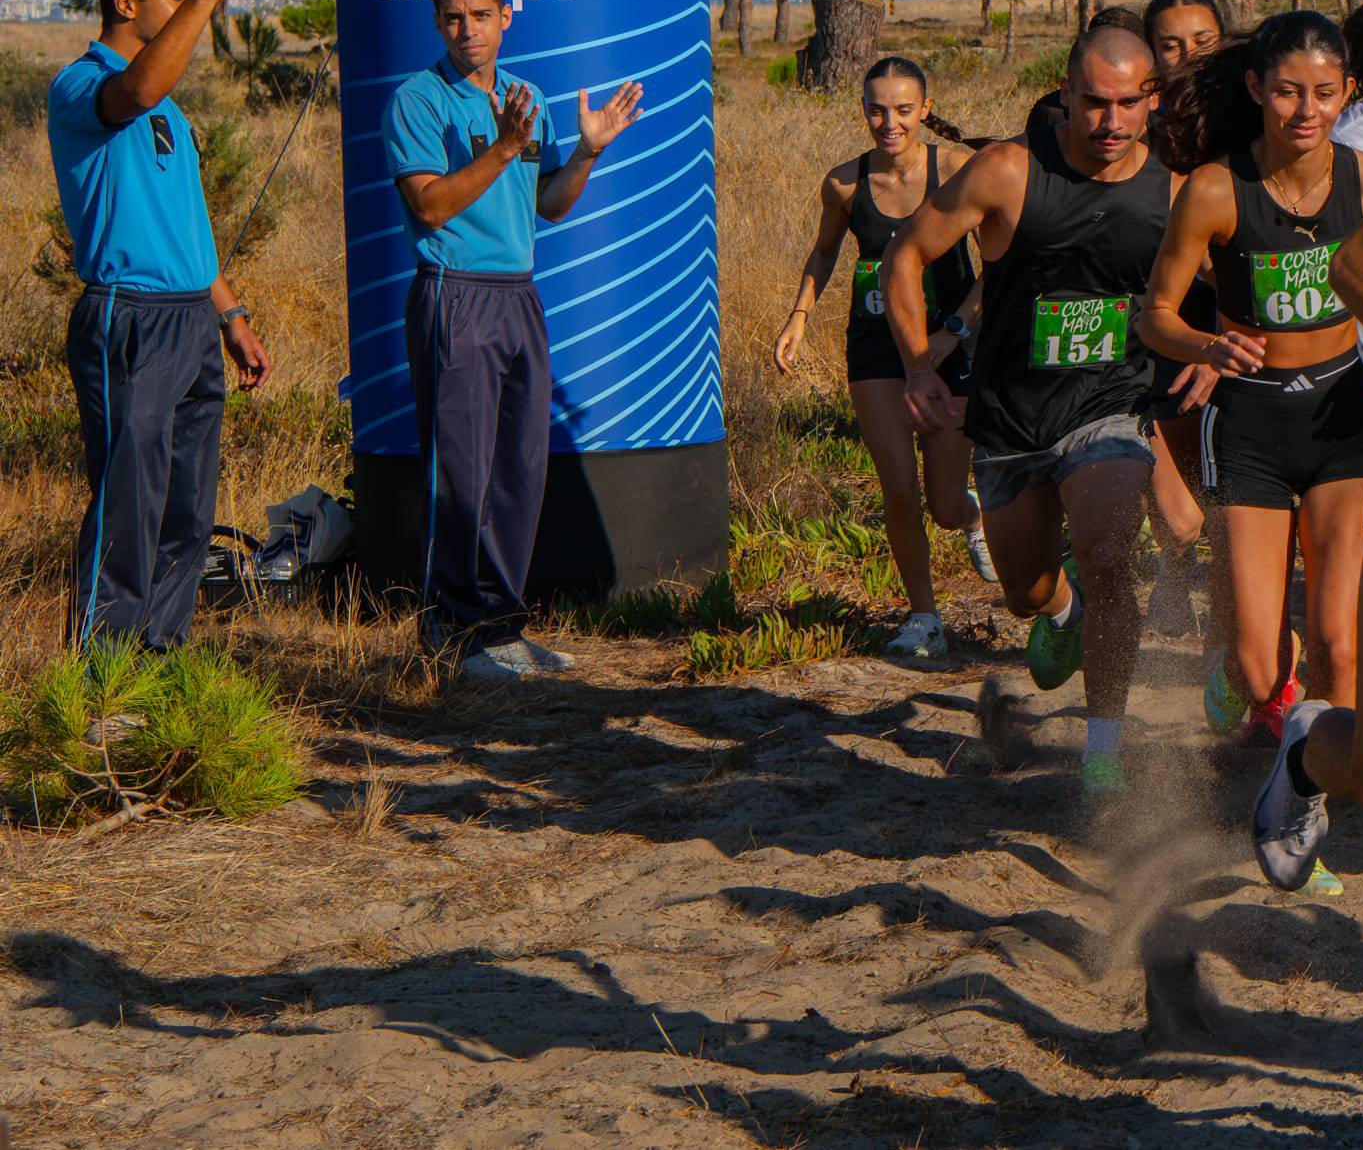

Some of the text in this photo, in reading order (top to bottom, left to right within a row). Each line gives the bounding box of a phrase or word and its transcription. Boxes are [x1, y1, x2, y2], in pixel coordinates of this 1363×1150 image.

[1282, 246, 1331, 271] CORTA
[1061, 299, 1104, 317] CORTA
[1045, 332, 1116, 364] 154
